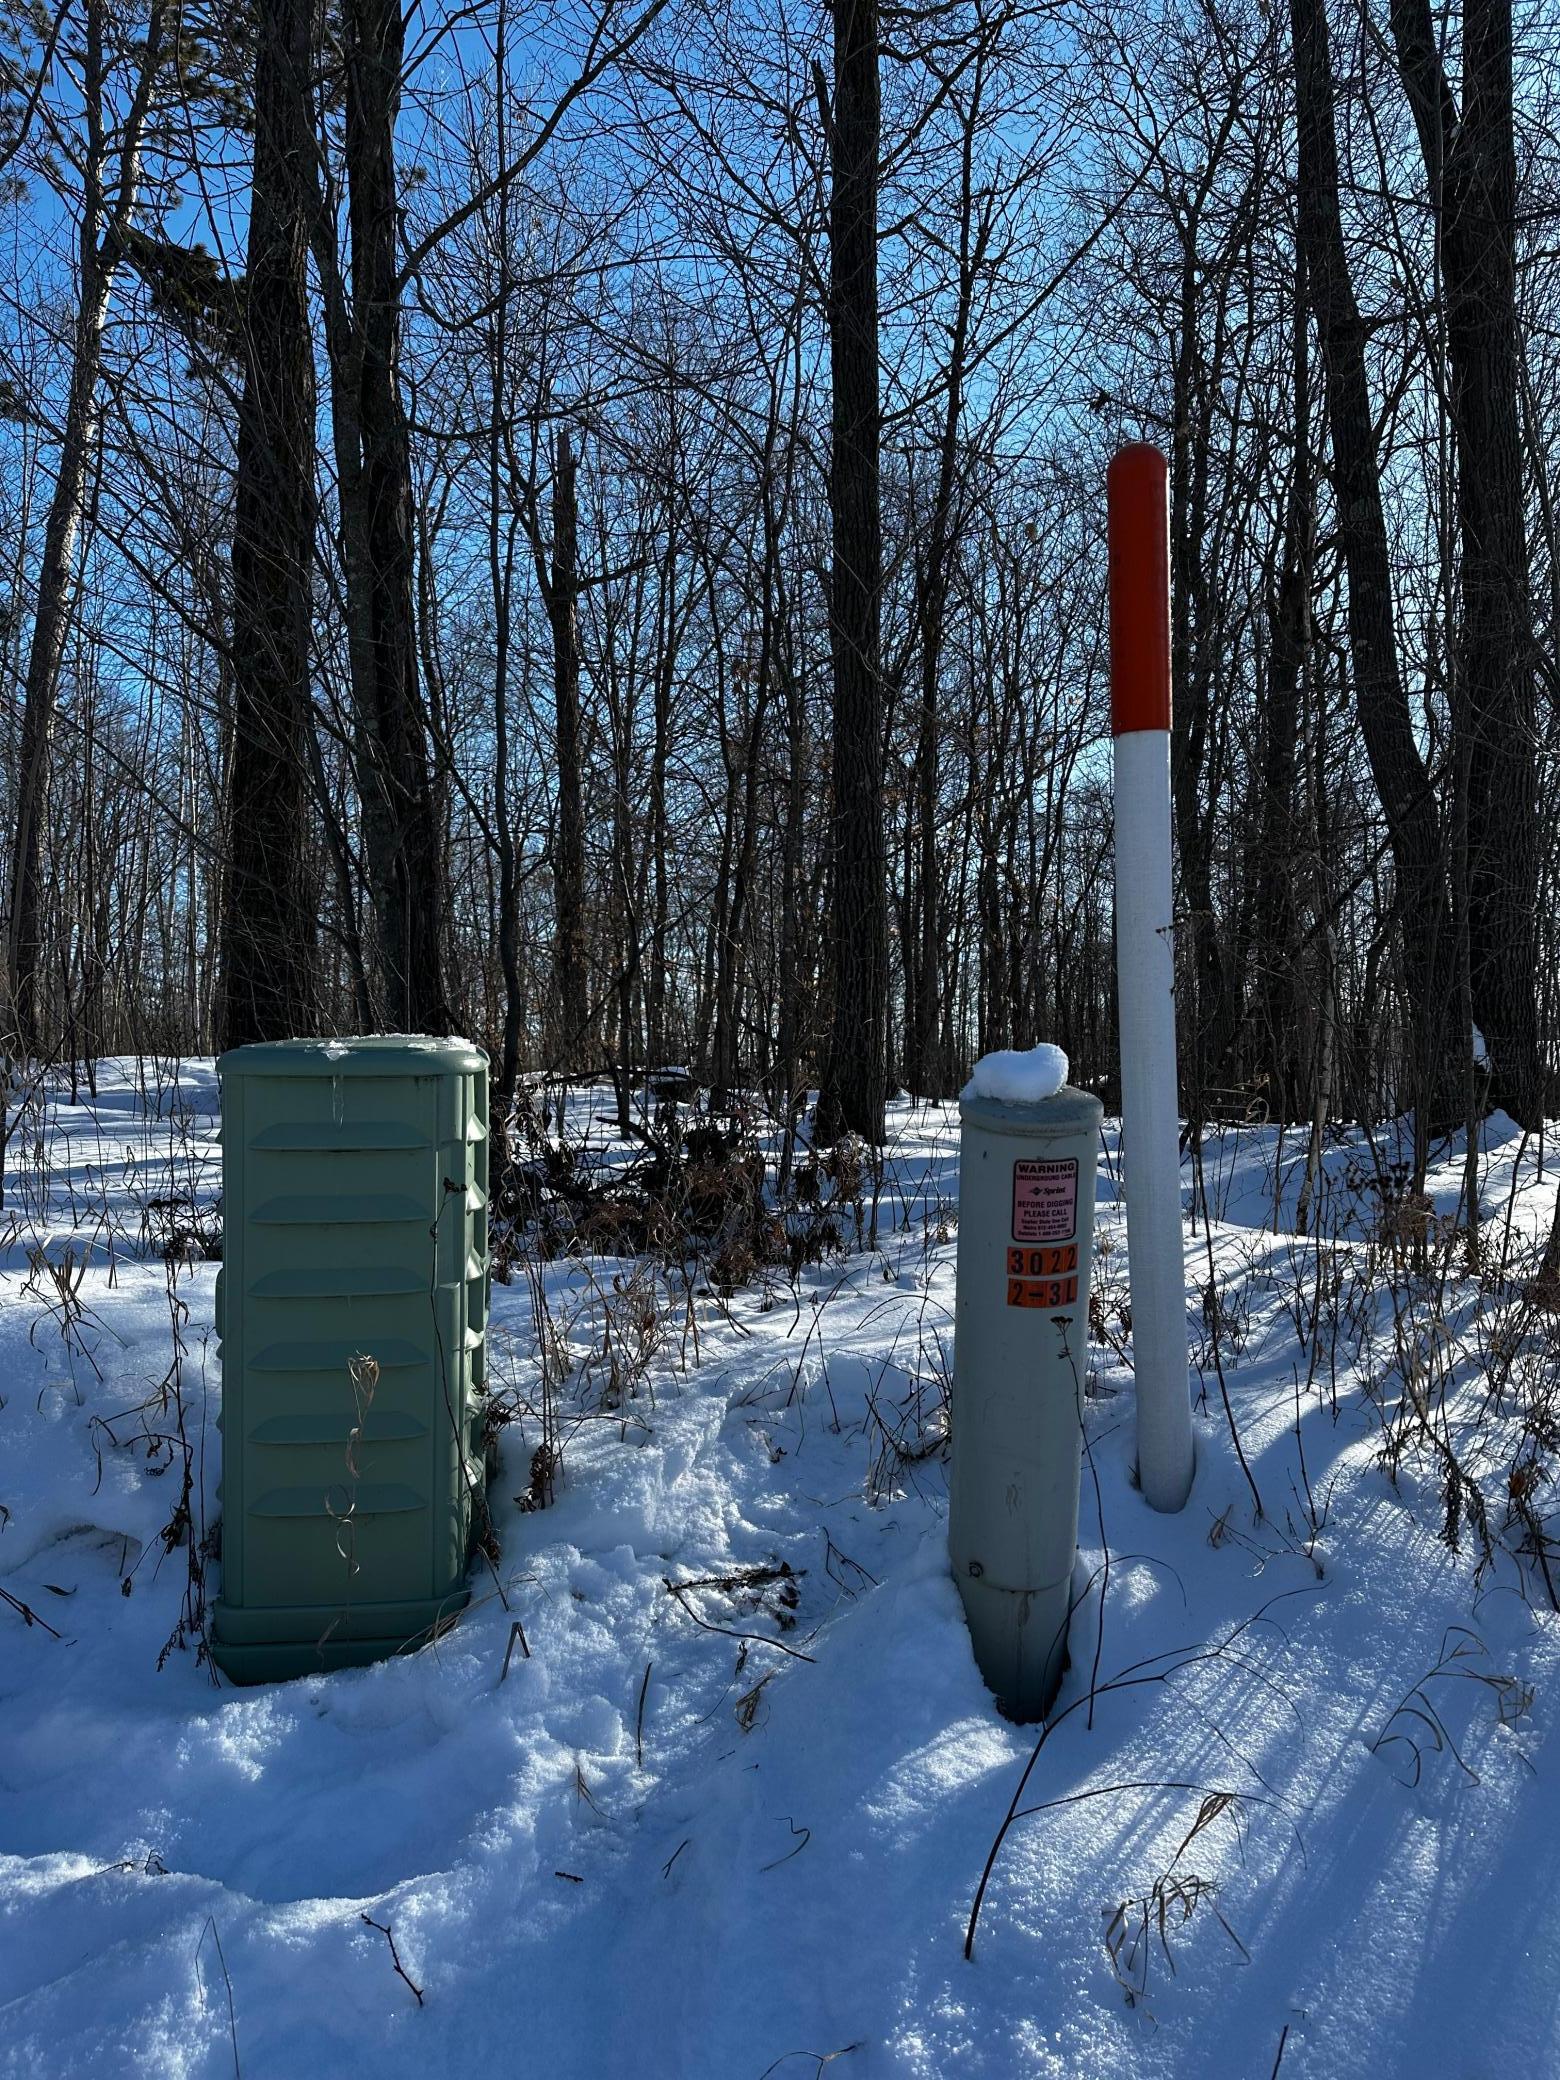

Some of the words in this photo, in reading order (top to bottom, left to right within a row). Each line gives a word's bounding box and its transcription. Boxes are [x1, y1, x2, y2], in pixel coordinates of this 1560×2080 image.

[1018, 1163, 1074, 1173] WARNING
[1043, 1187, 1066, 1196] Sprint
[1046, 1198, 1073, 1207] DIGGING
[1011, 1247, 1077, 1275] 3022
